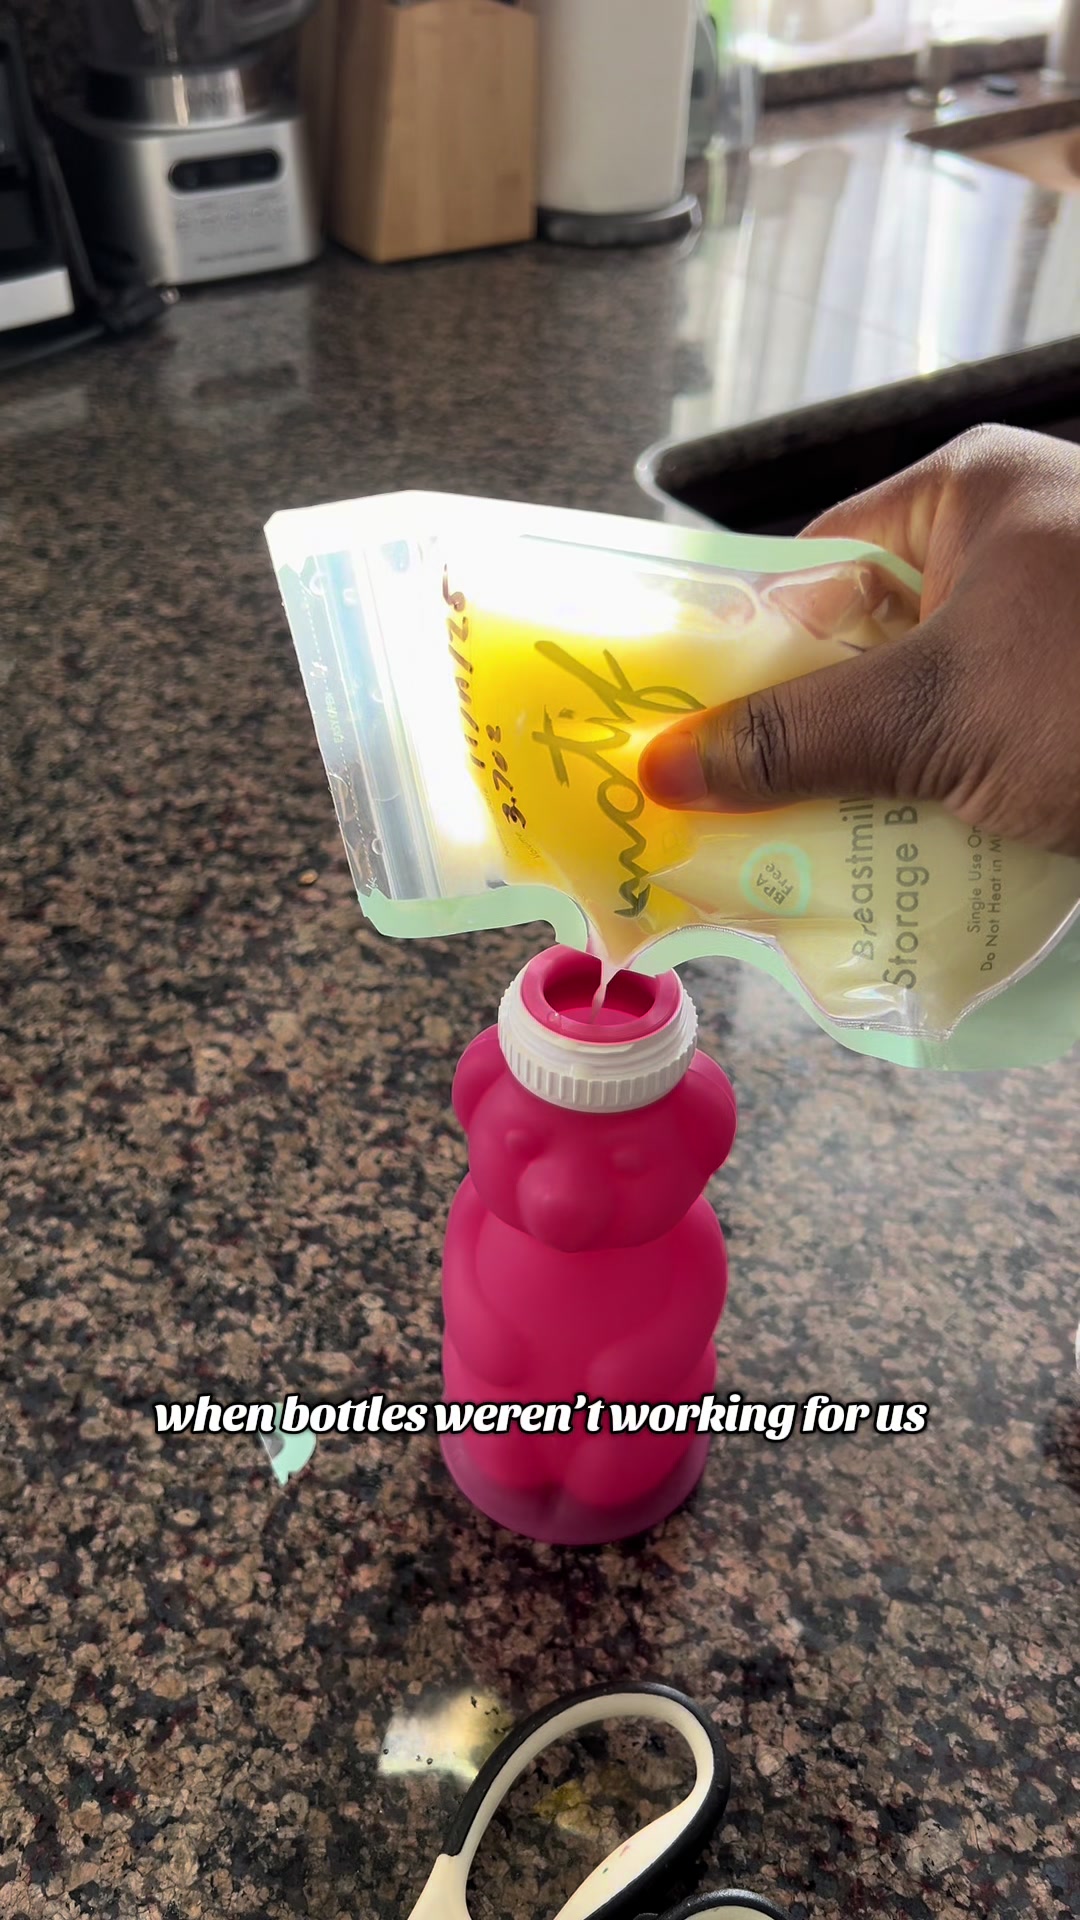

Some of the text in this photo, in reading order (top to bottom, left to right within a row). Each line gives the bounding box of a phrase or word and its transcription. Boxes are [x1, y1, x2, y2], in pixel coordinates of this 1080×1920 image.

[532, 640, 708, 918] motif
[764, 862, 795, 897] Free
[968, 854, 982, 881] Use
[989, 858, 1001, 873] in
[755, 872, 787, 906] BPA
[988, 878, 1002, 912] Heat
[882, 843, 929, 990] Storage
[967, 888, 985, 933] Single
[985, 919, 999, 947] Not
[980, 952, 996, 972] Do
